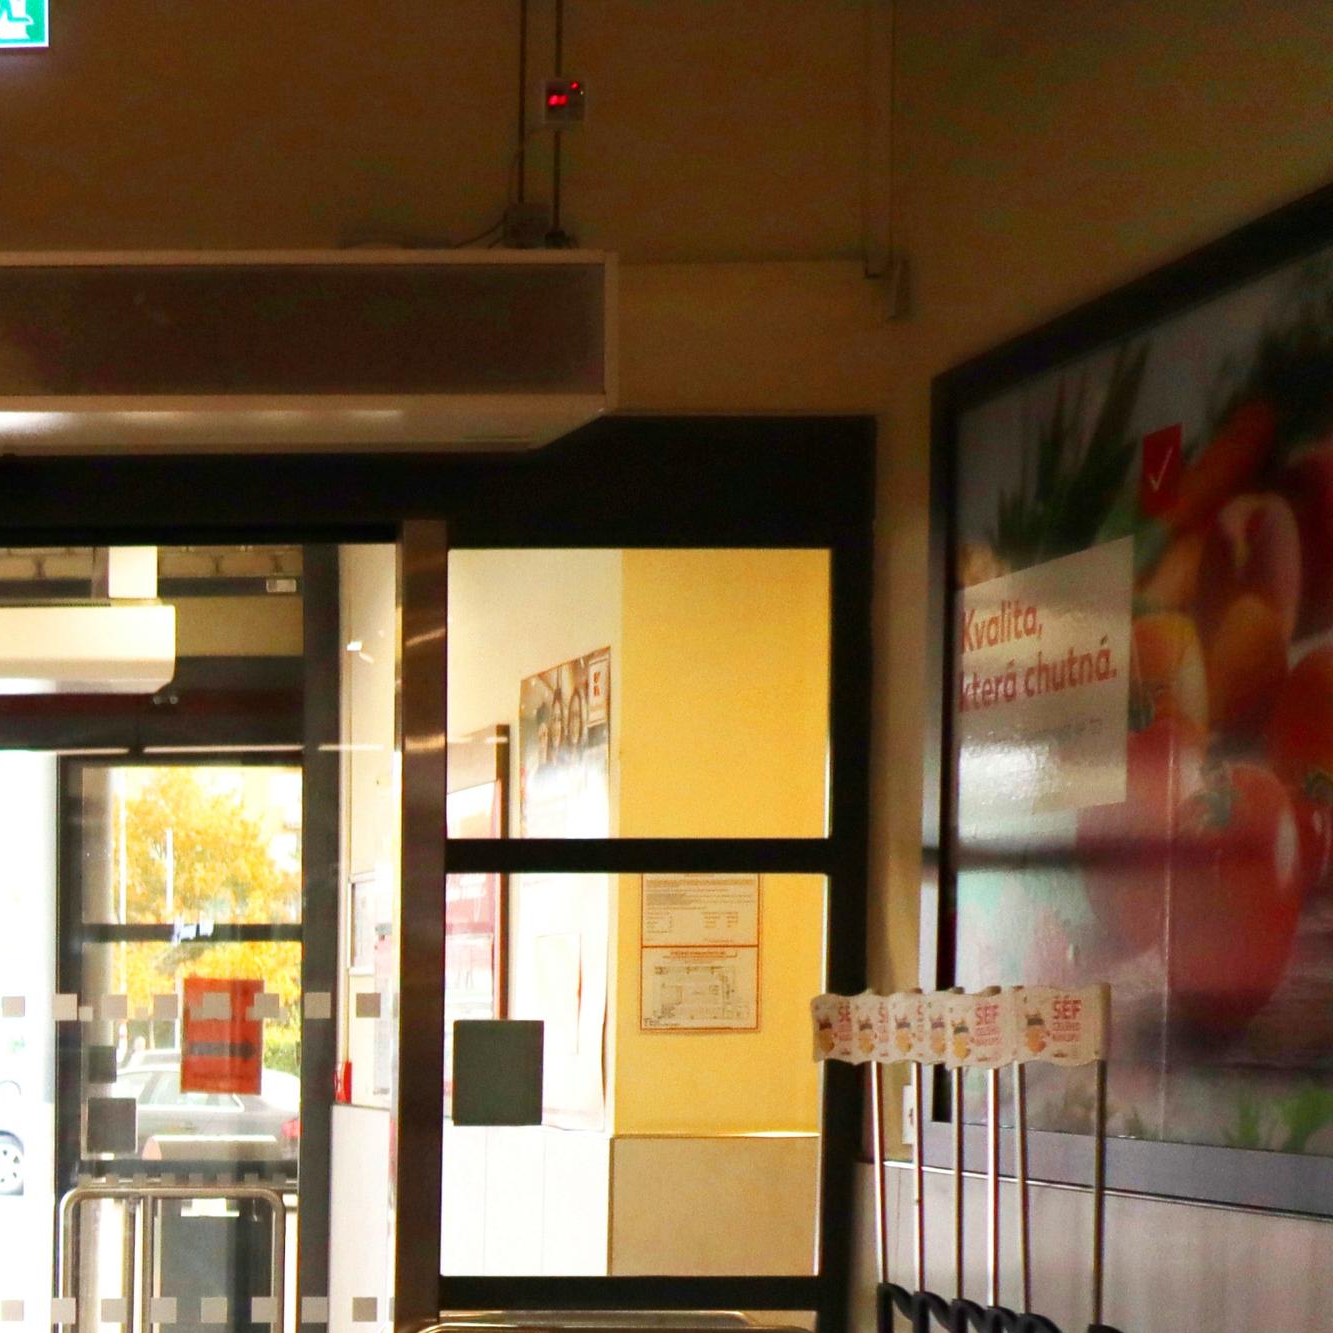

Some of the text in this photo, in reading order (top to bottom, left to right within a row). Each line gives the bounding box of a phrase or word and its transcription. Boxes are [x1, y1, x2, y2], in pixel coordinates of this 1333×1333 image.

[962, 600, 1043, 651] Kvalita,
[960, 634, 1118, 712] která chutná.
